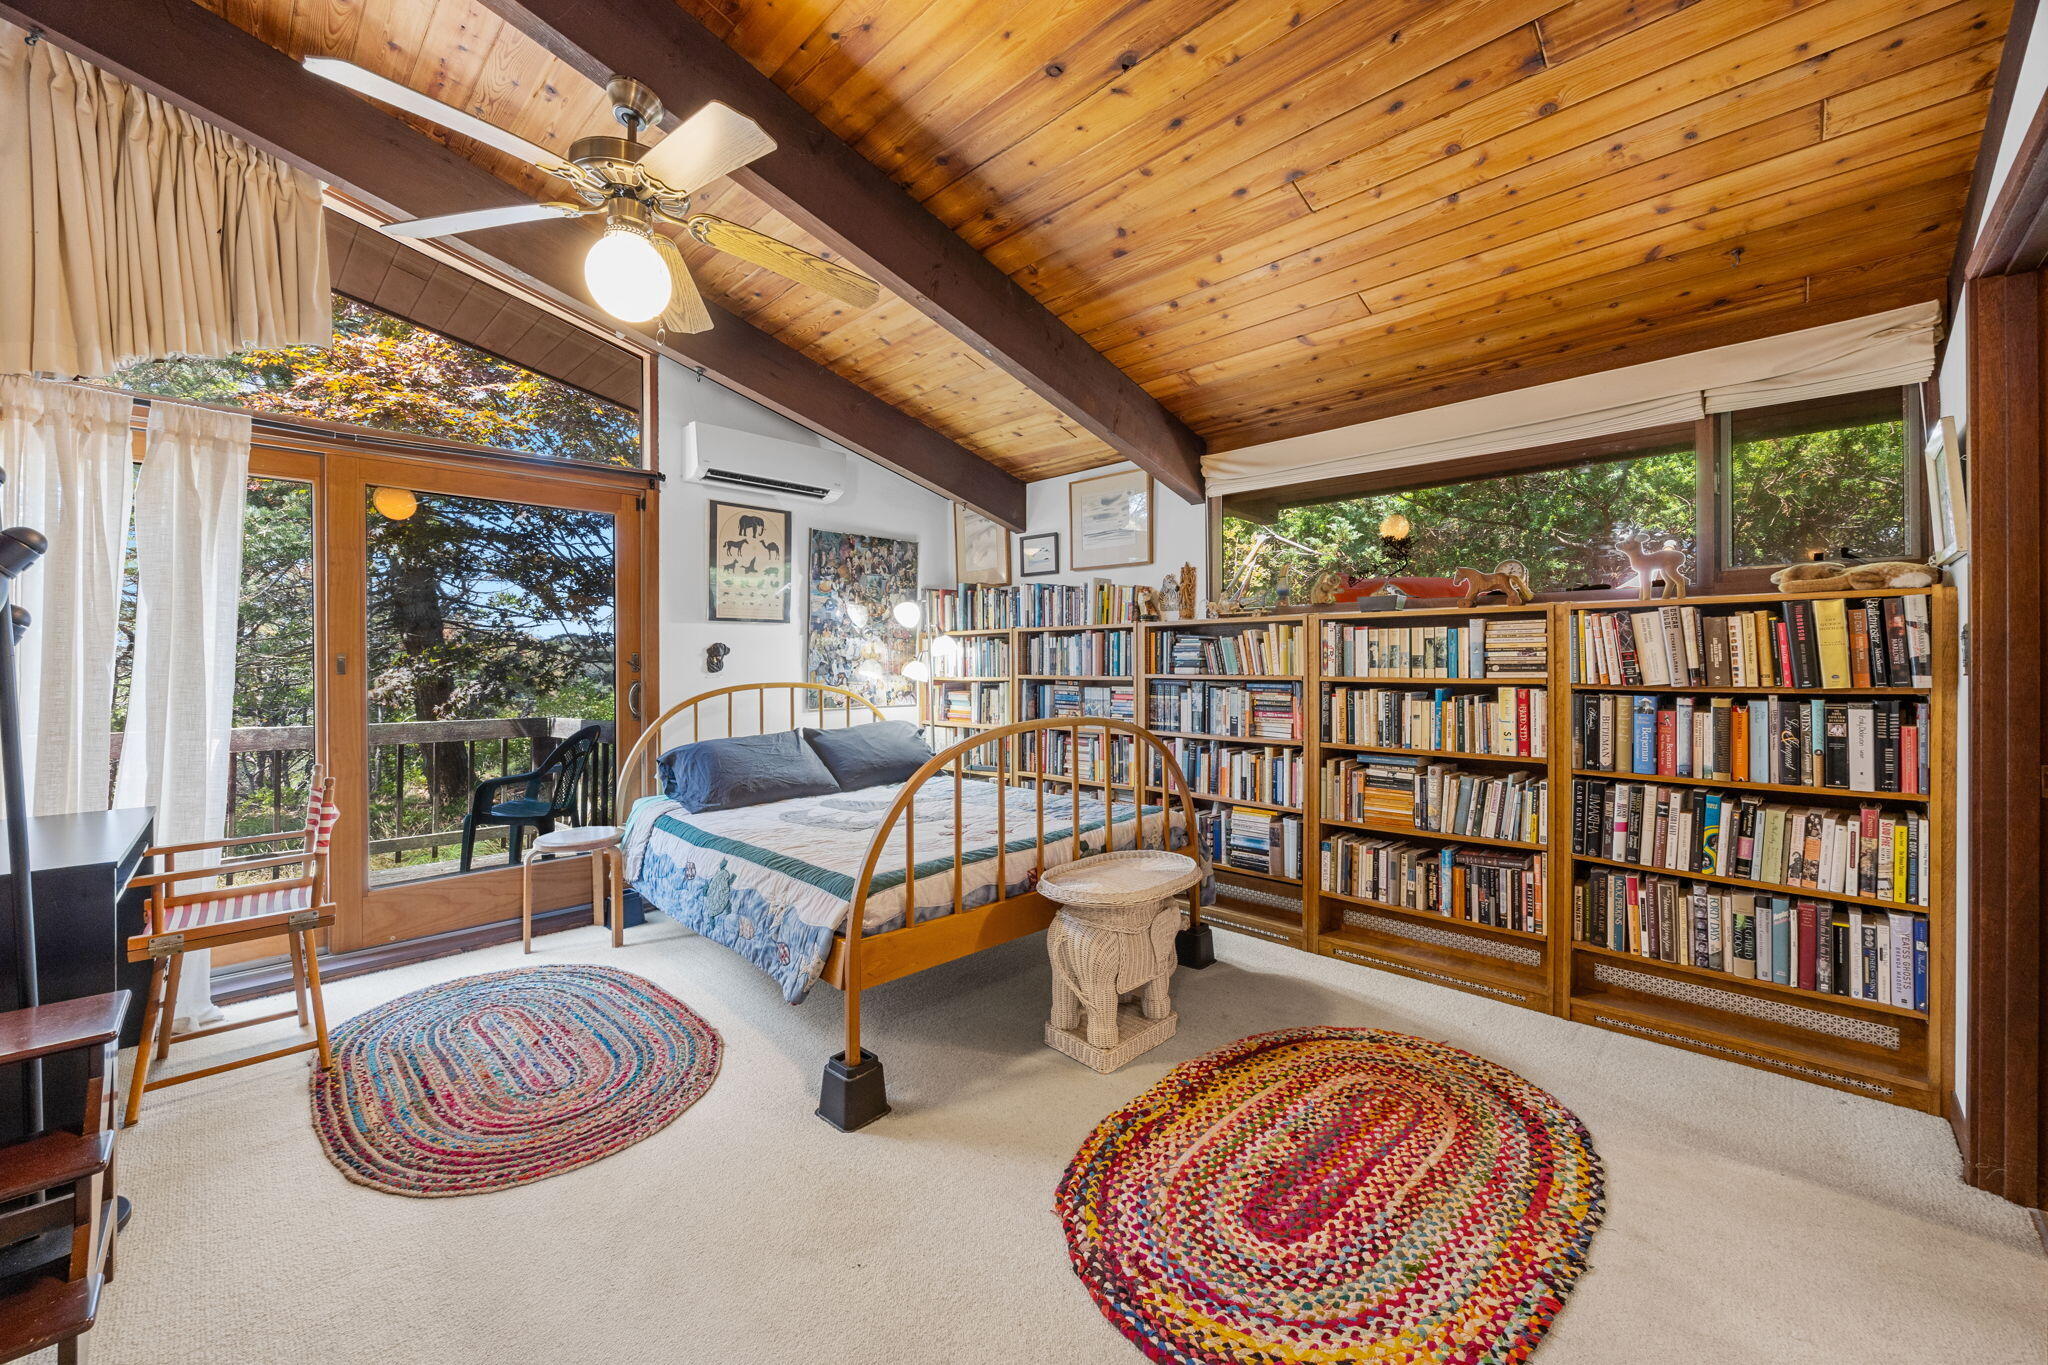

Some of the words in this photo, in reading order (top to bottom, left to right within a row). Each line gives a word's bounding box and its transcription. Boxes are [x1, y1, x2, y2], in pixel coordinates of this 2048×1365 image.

[1662, 609, 1672, 630] WILDE
[1670, 608, 1680, 629] OSCAR
[1891, 638, 1900, 665] MARLOWE
[1801, 708, 1811, 732] NOTES
[1601, 715, 1611, 759] BETJEMAN
[1641, 727, 1652, 762] Betjeman
[1665, 743, 1674, 769] Betjeman
[1575, 807, 1583, 832] GRANT
[1587, 800, 1601, 835] MARTHA
[1881, 822, 1893, 835] SLOW
[1881, 835, 1893, 848] FIRE
[1615, 879, 1623, 896] MAX
[1614, 897, 1623, 926] PERKINS
[1709, 897, 1720, 920] FORTY
[1709, 922, 1721, 941] DAYS
[1902, 961, 1912, 990] GHOSTS
